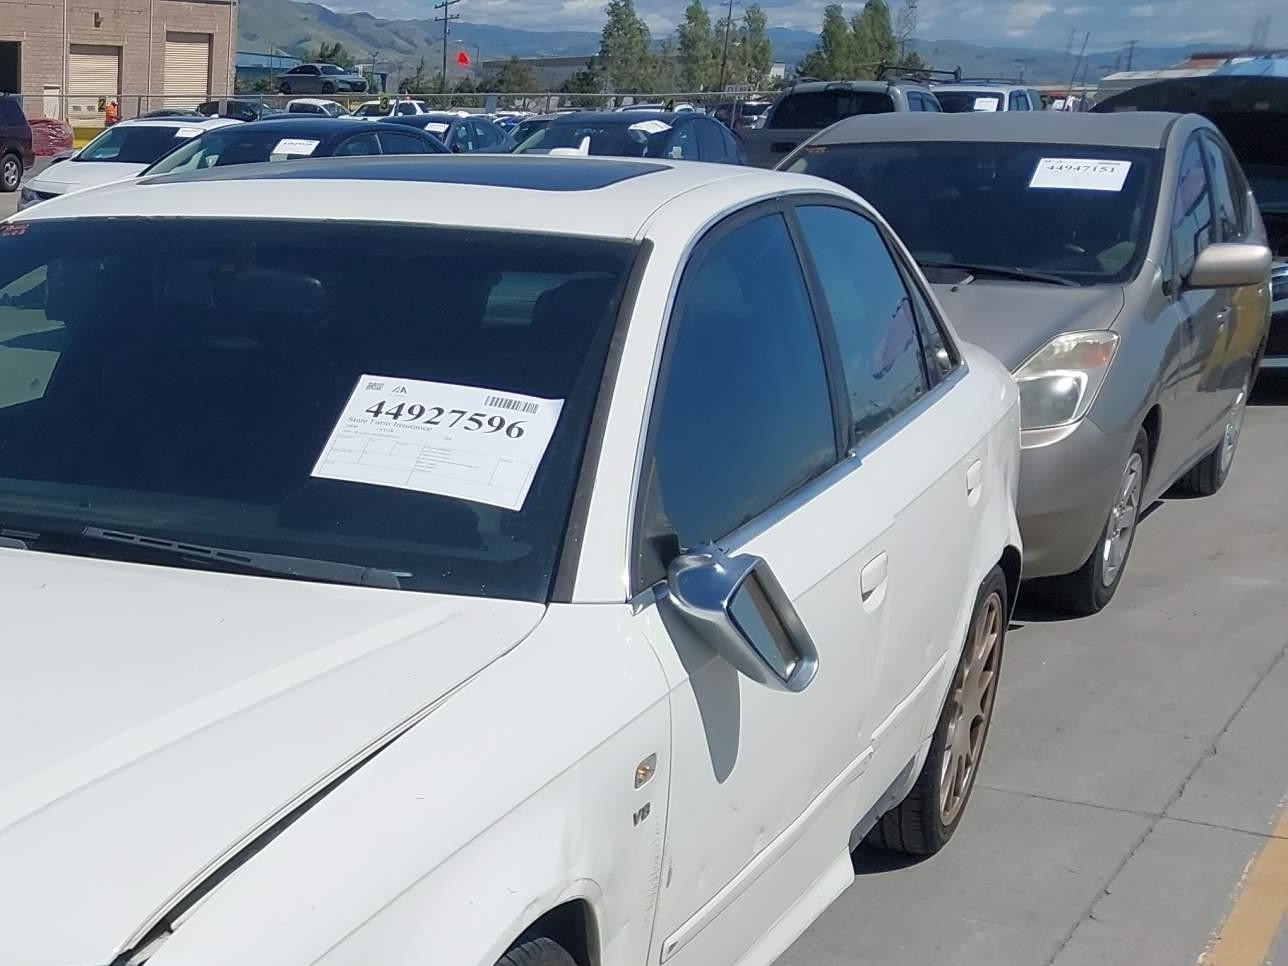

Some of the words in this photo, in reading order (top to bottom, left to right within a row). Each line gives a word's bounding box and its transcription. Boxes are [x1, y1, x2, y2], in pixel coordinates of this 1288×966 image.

[1047, 165, 1116, 173] 44947151
[349, 416, 368, 424] State
[369, 418, 391, 427] Farm
[393, 421, 433, 432] Insurance
[365, 400, 529, 439] 44927596
